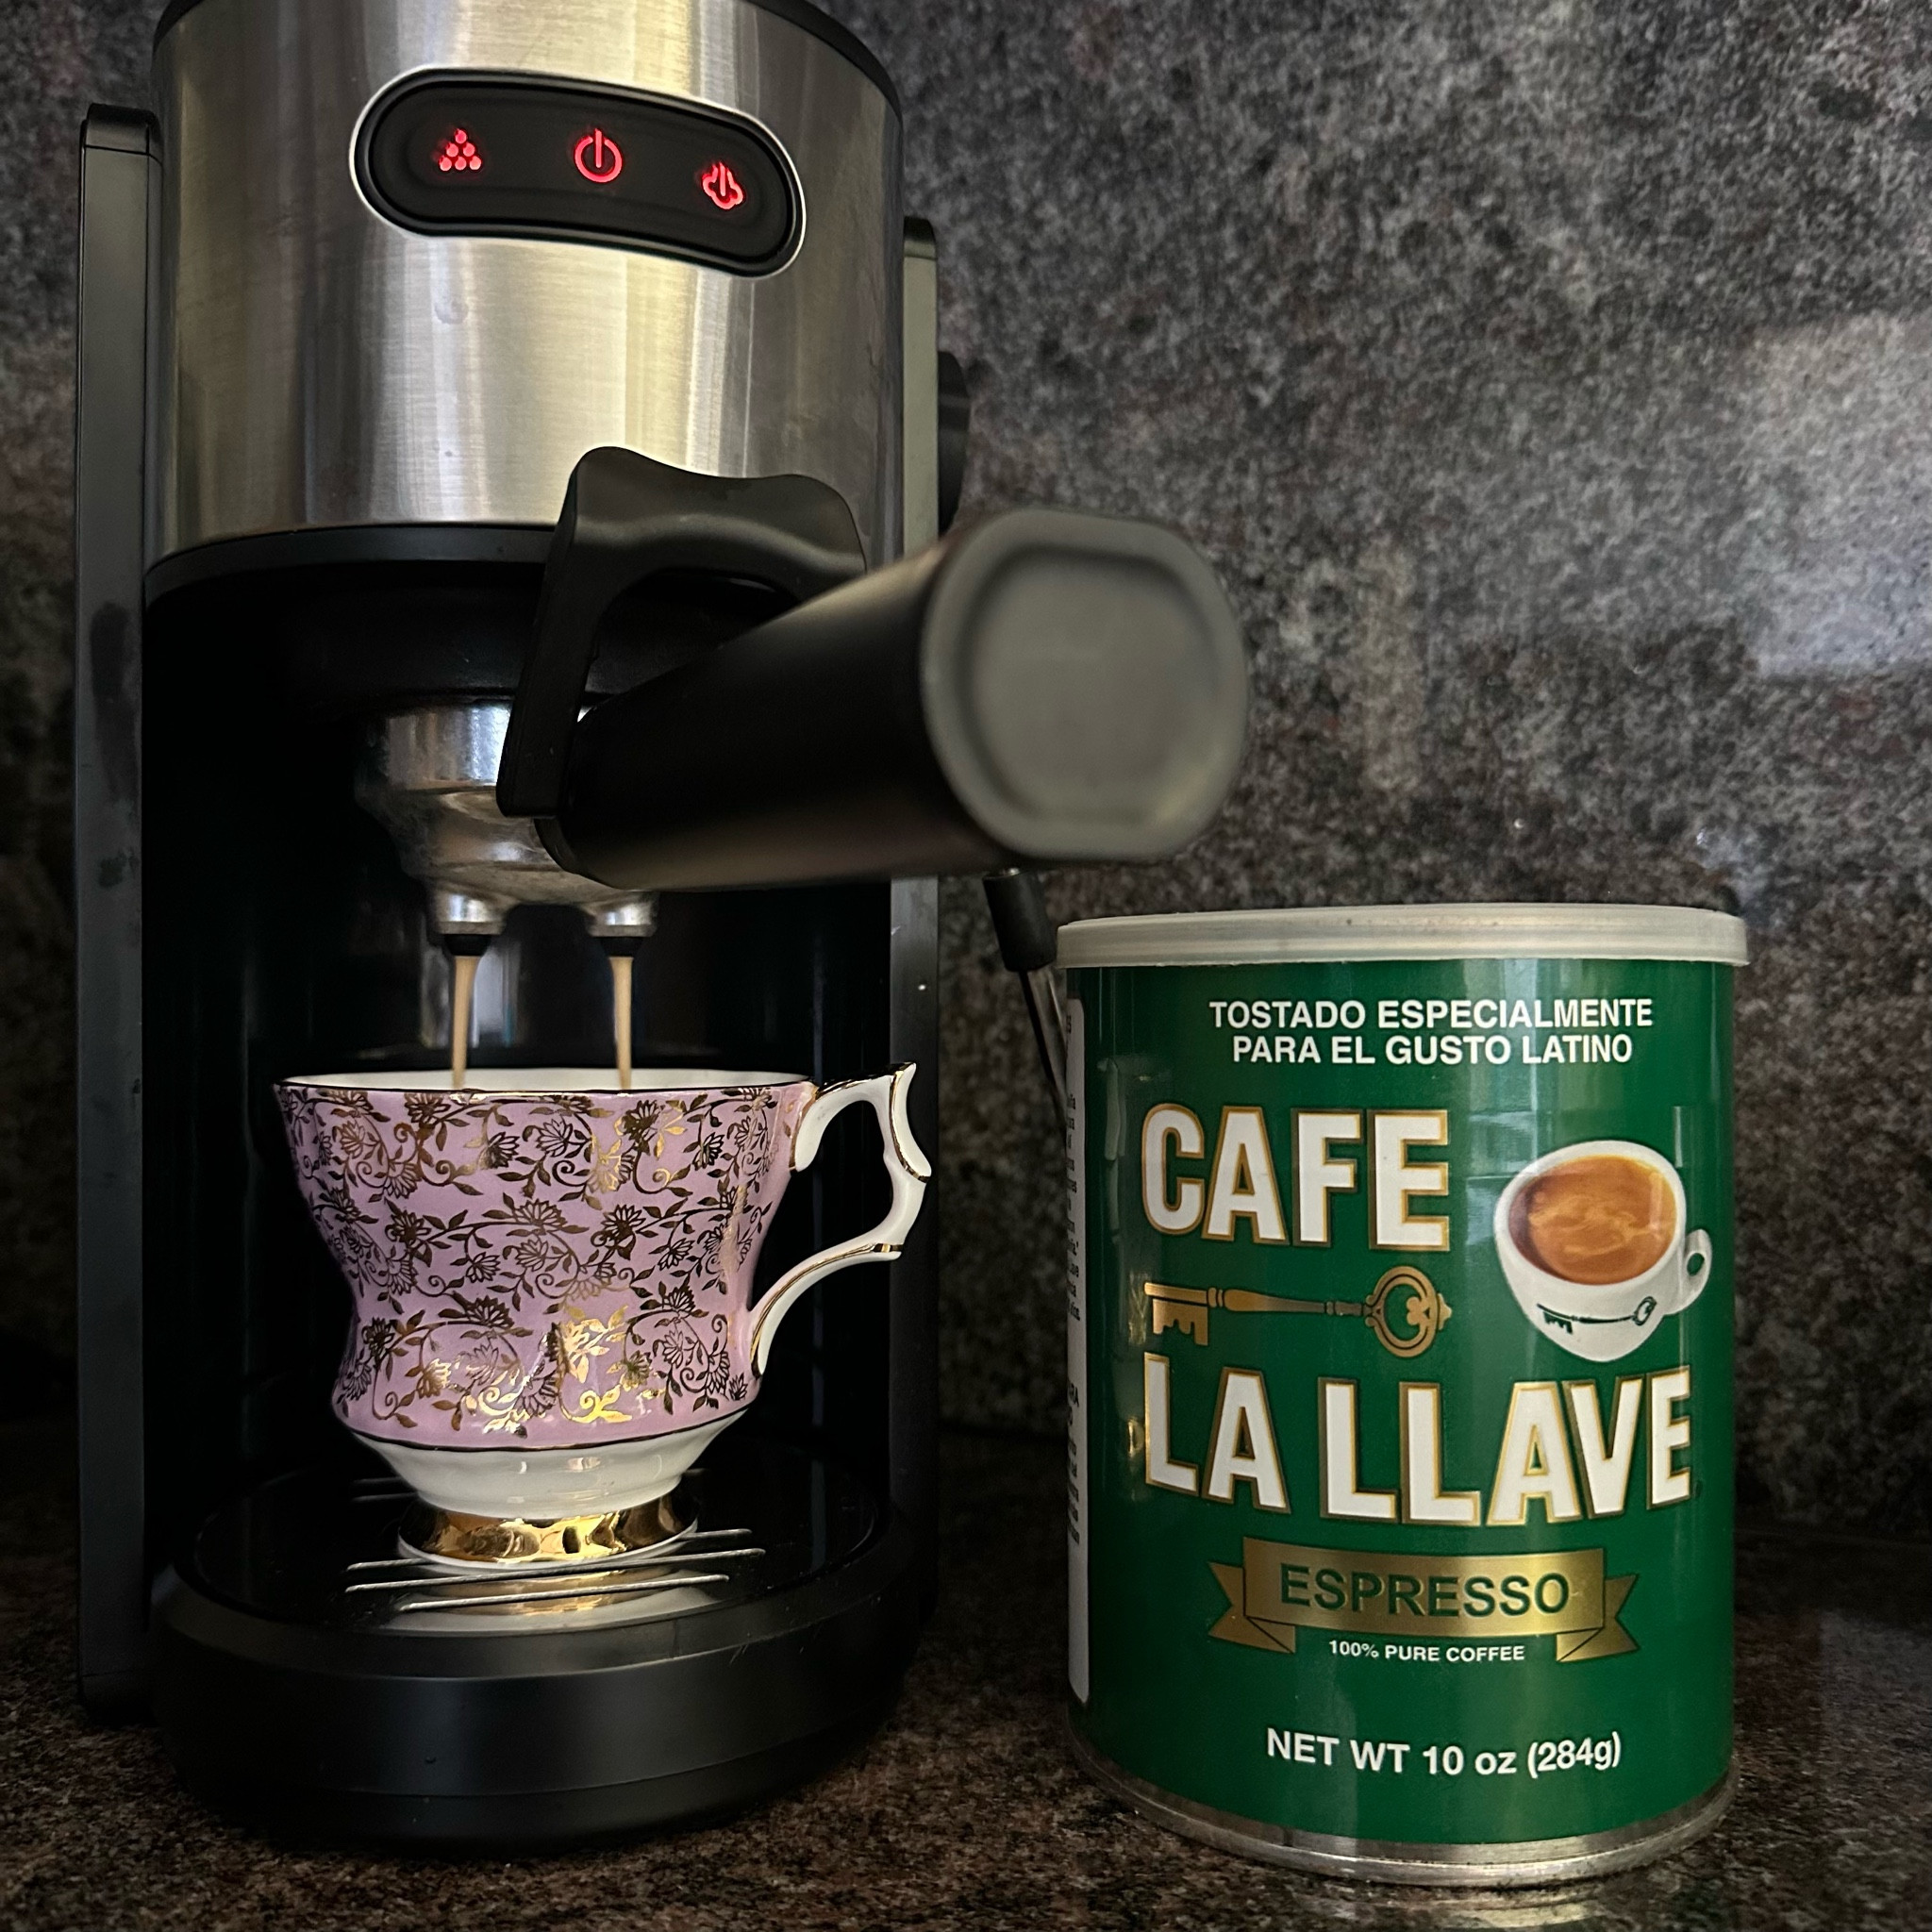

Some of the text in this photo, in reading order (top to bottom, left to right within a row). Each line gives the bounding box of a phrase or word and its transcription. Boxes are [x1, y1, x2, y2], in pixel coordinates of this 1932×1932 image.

[1209, 997, 1655, 1030] TOSTADO ESPECIALMENTE
[1233, 1034, 1634, 1066] PARA EL GUSTO LATINO
[1141, 1103, 1451, 1253] CAFE
[1143, 1352, 1291, 1514] LA
[1319, 1365, 1693, 1527] LLAVE
[1278, 1562, 1570, 1618] ESPRESSO
[1328, 1640, 1526, 1663] 100% PURE COFFEE
[1266, 1727, 1623, 1780] NET WT 10 oz (284g)
